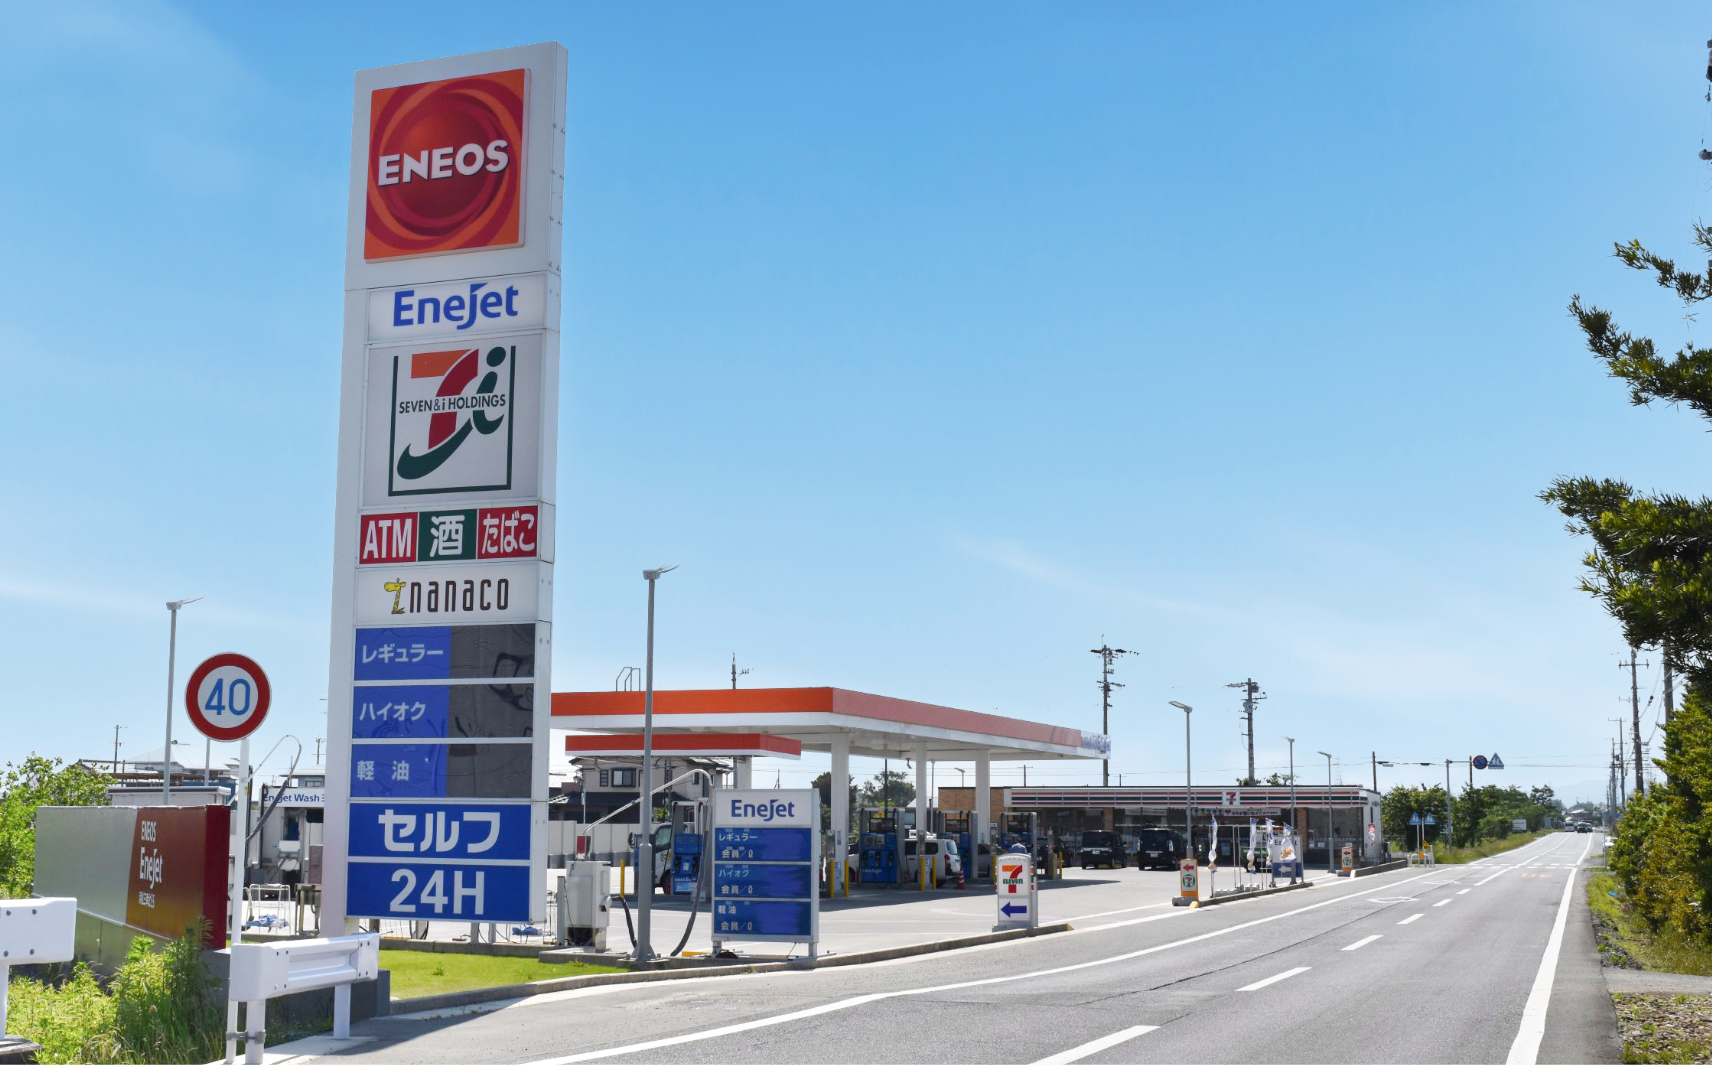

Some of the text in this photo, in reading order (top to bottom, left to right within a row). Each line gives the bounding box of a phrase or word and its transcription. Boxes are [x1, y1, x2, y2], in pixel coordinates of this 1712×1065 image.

[378, 139, 509, 186] ENEOS
[448, 394, 506, 410] HOLDINGS
[363, 519, 412, 559] ATM
[430, 514, 465, 557] 酒
[482, 510, 535, 554] たばこ
[409, 578, 509, 613] nanaco
[362, 643, 443, 663] レギュラー
[205, 678, 250, 715] 40
[359, 702, 426, 721] ハイオク
[294, 794, 320, 802] Wash
[141, 821, 157, 842] ENEOS
[378, 809, 500, 853] セルフ
[719, 833, 758, 842] レギュラー
[389, 868, 485, 914] 24H
[719, 869, 749, 878] ハイオク
